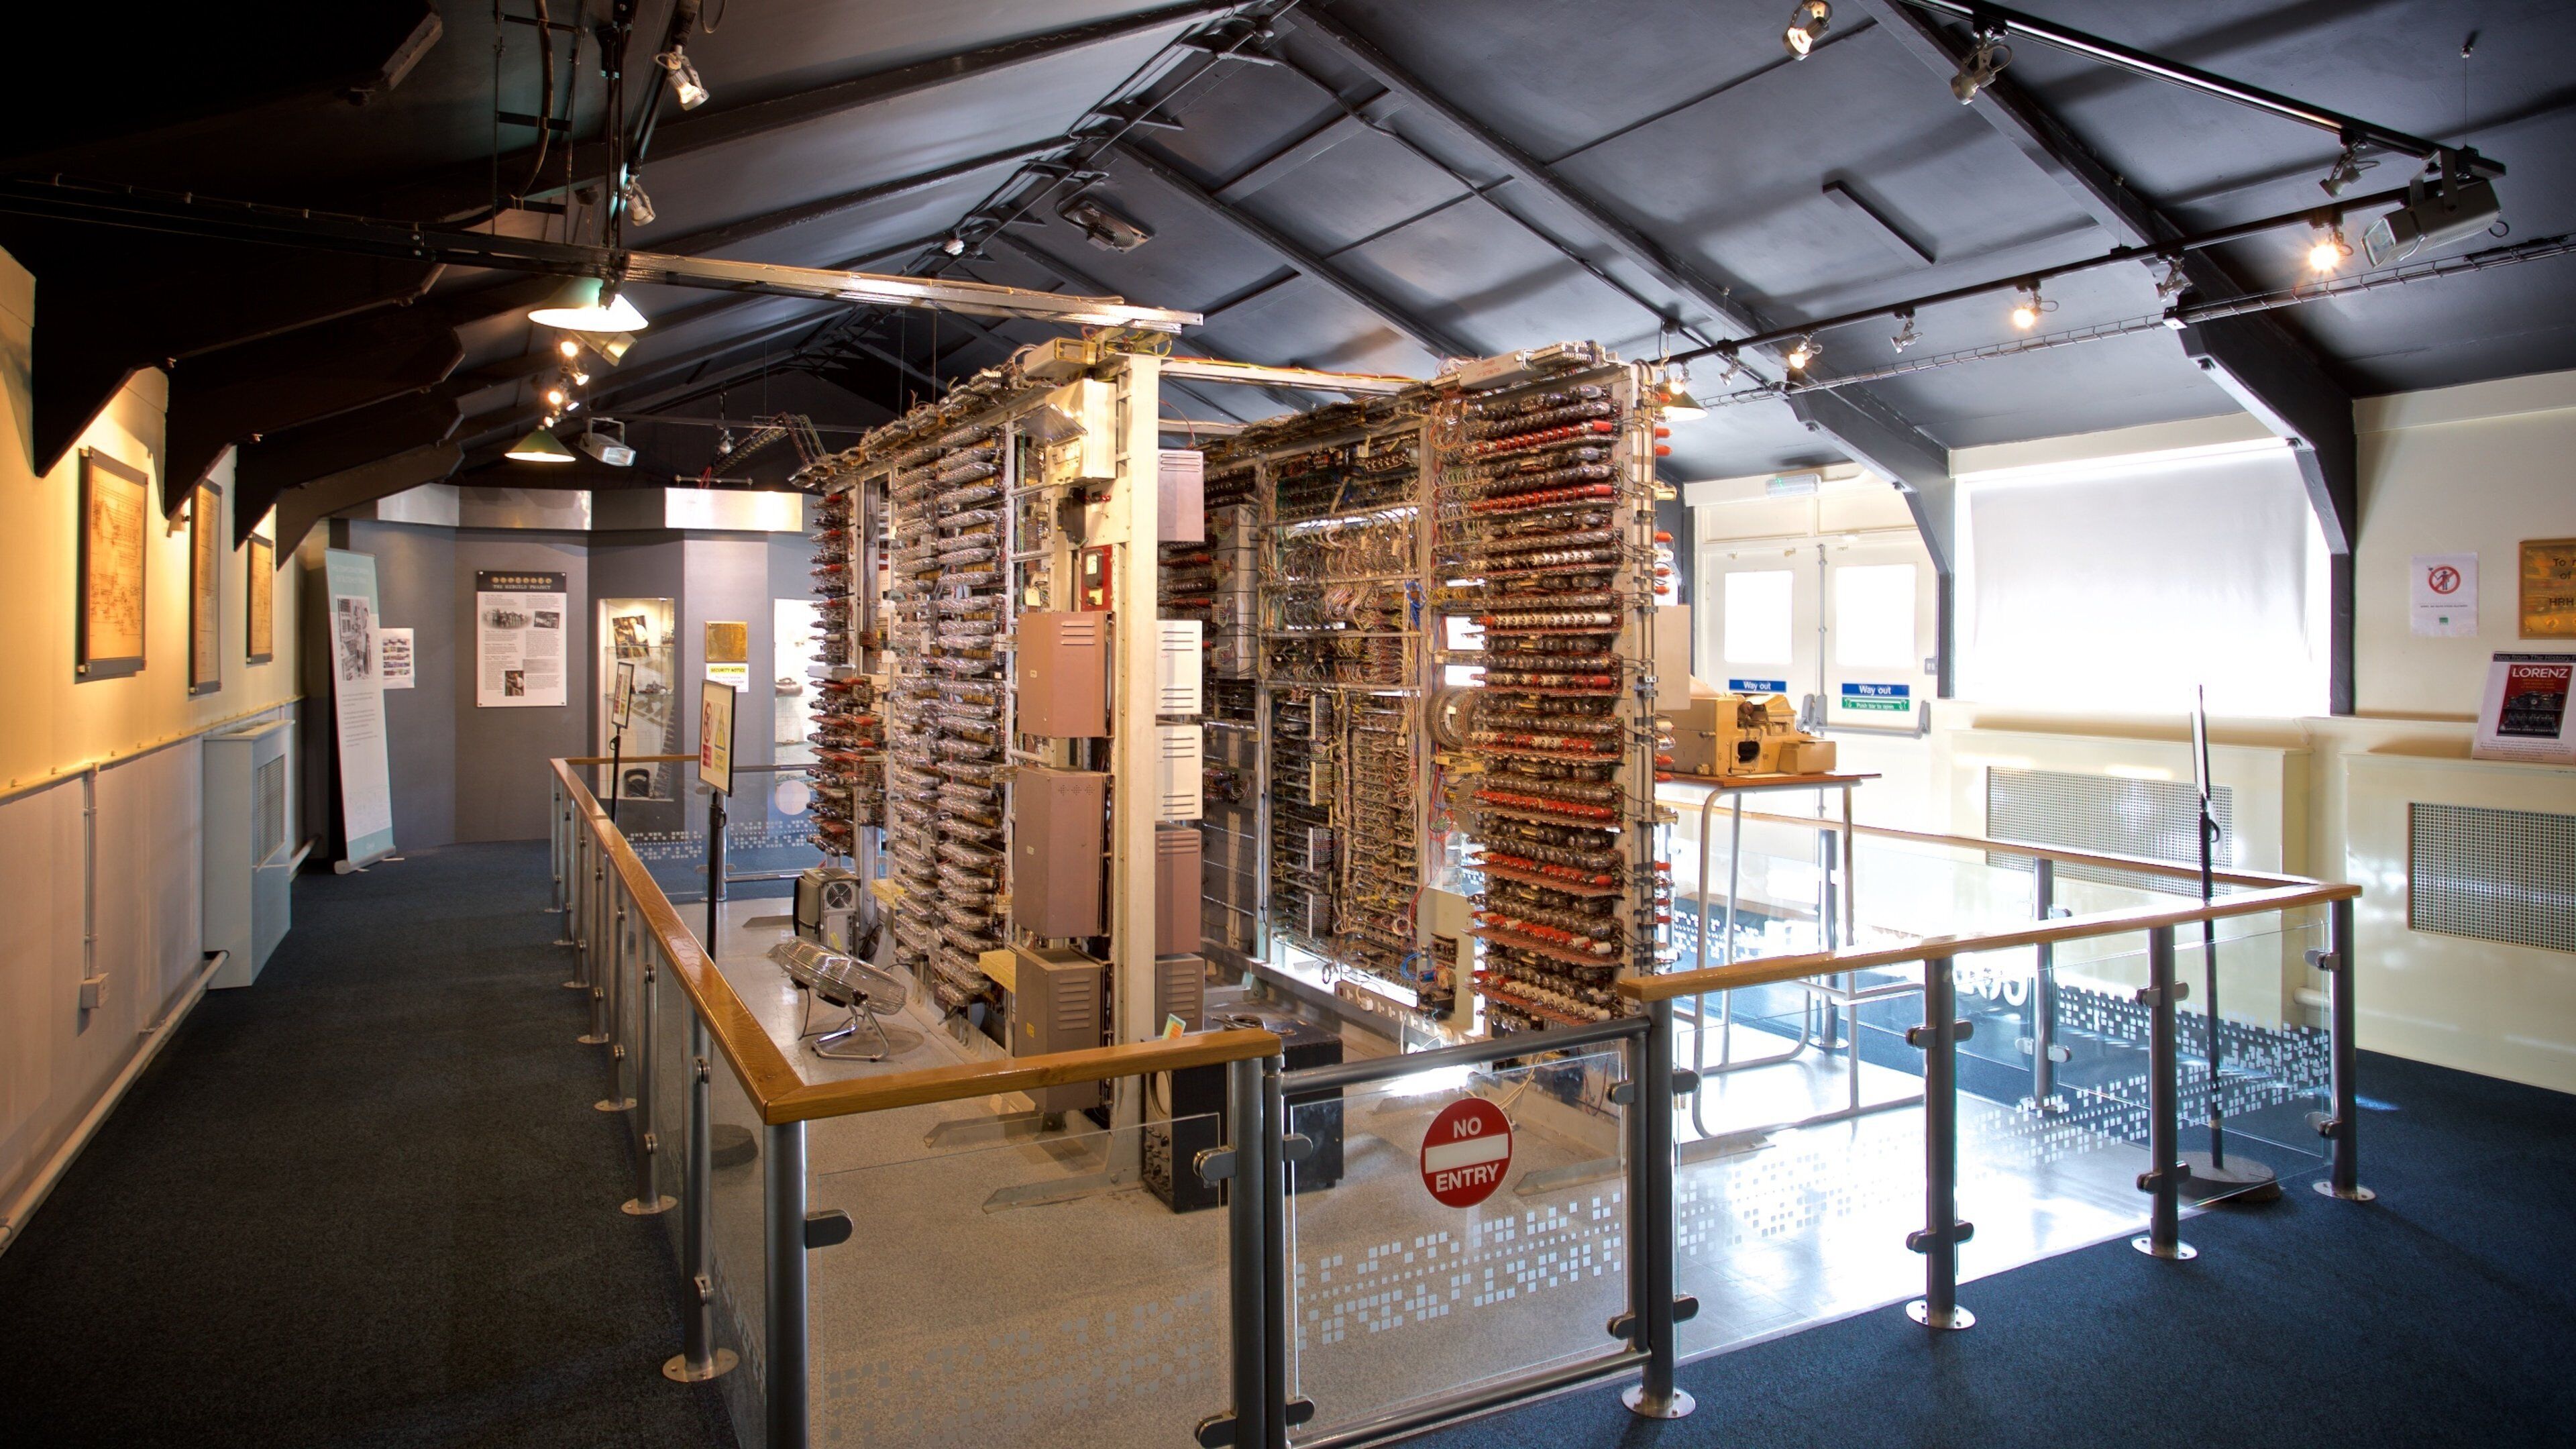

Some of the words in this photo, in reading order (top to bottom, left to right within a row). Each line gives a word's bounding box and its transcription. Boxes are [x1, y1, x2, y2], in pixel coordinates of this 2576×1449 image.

[2553, 558, 2566, 567] To
[2560, 571, 2571, 580] of
[2549, 598, 2574, 606] HRH
[2512, 667, 2569, 678] LORENZ
[1743, 681, 1758, 691] Way
[1760, 682, 1771, 690] out
[1858, 685, 1876, 696] Way
[1878, 686, 1891, 694] out
[1453, 1117, 1482, 1138] NO
[1436, 1163, 1500, 1193] ENTRY
